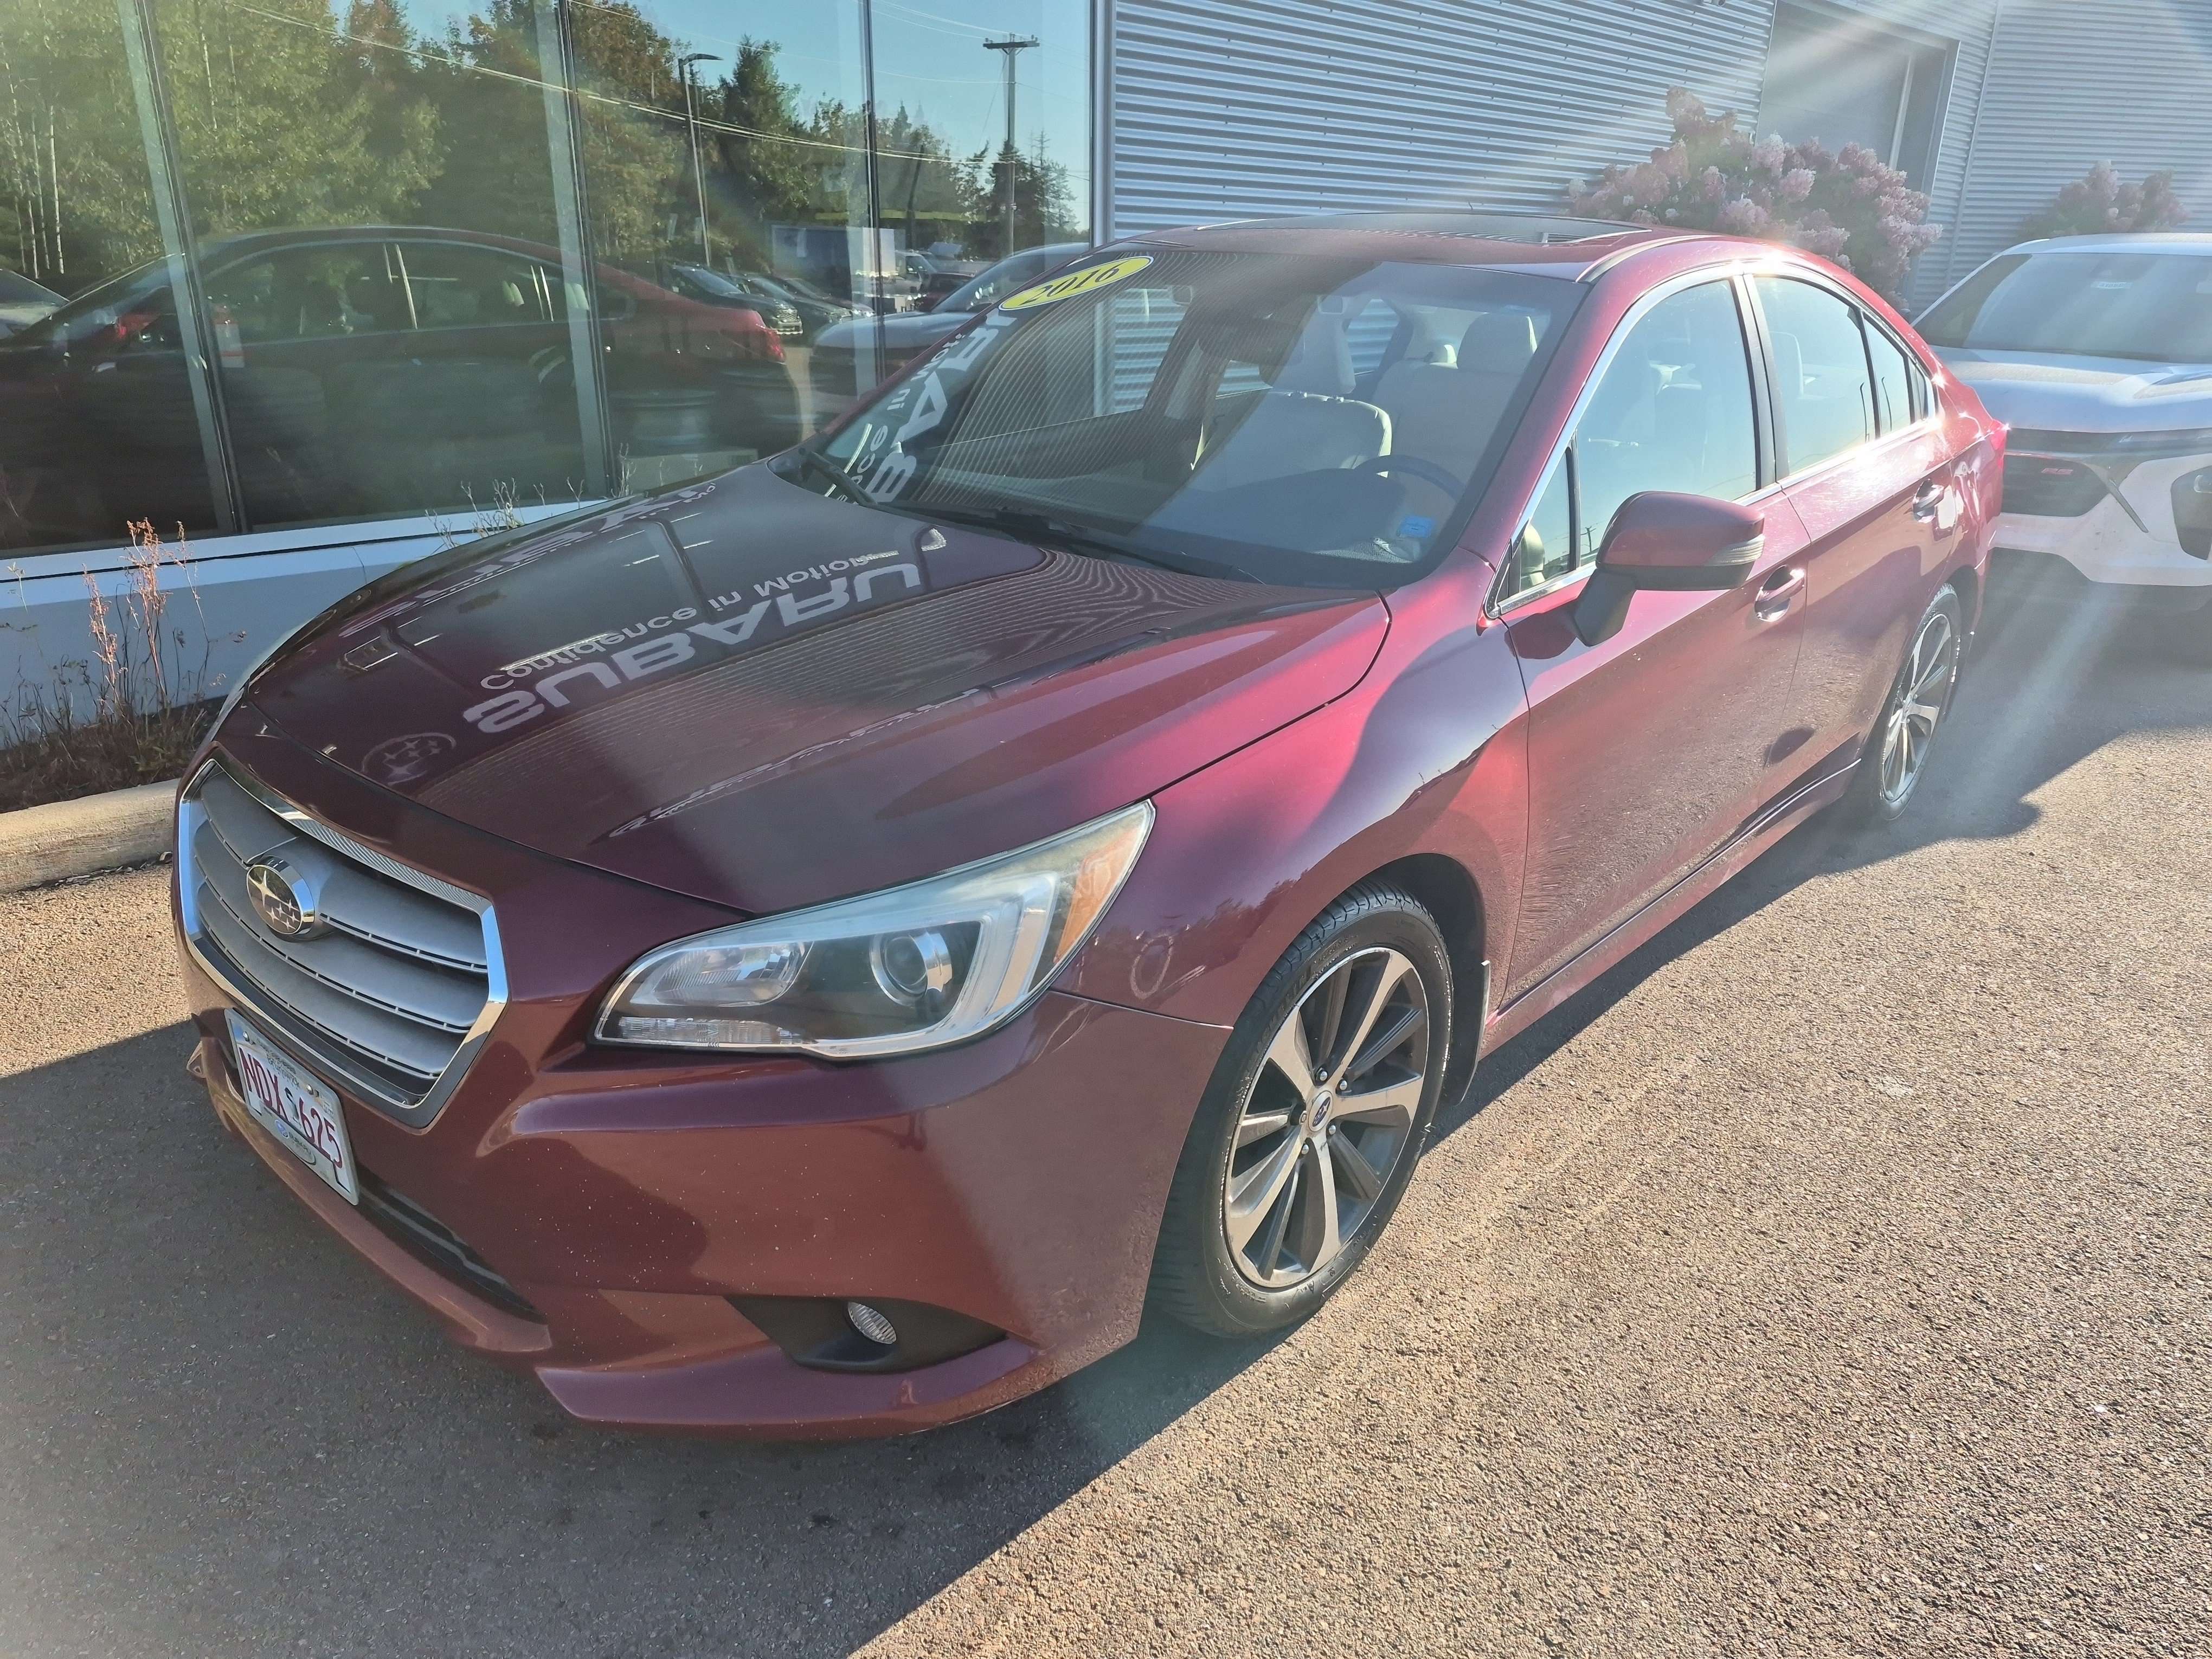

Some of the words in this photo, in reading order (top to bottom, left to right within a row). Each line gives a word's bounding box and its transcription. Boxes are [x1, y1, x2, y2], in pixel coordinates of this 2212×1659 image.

[1018, 260, 1130, 306] 2016
[239, 1047, 290, 1123] NDX
[299, 1097, 343, 1168] 625
